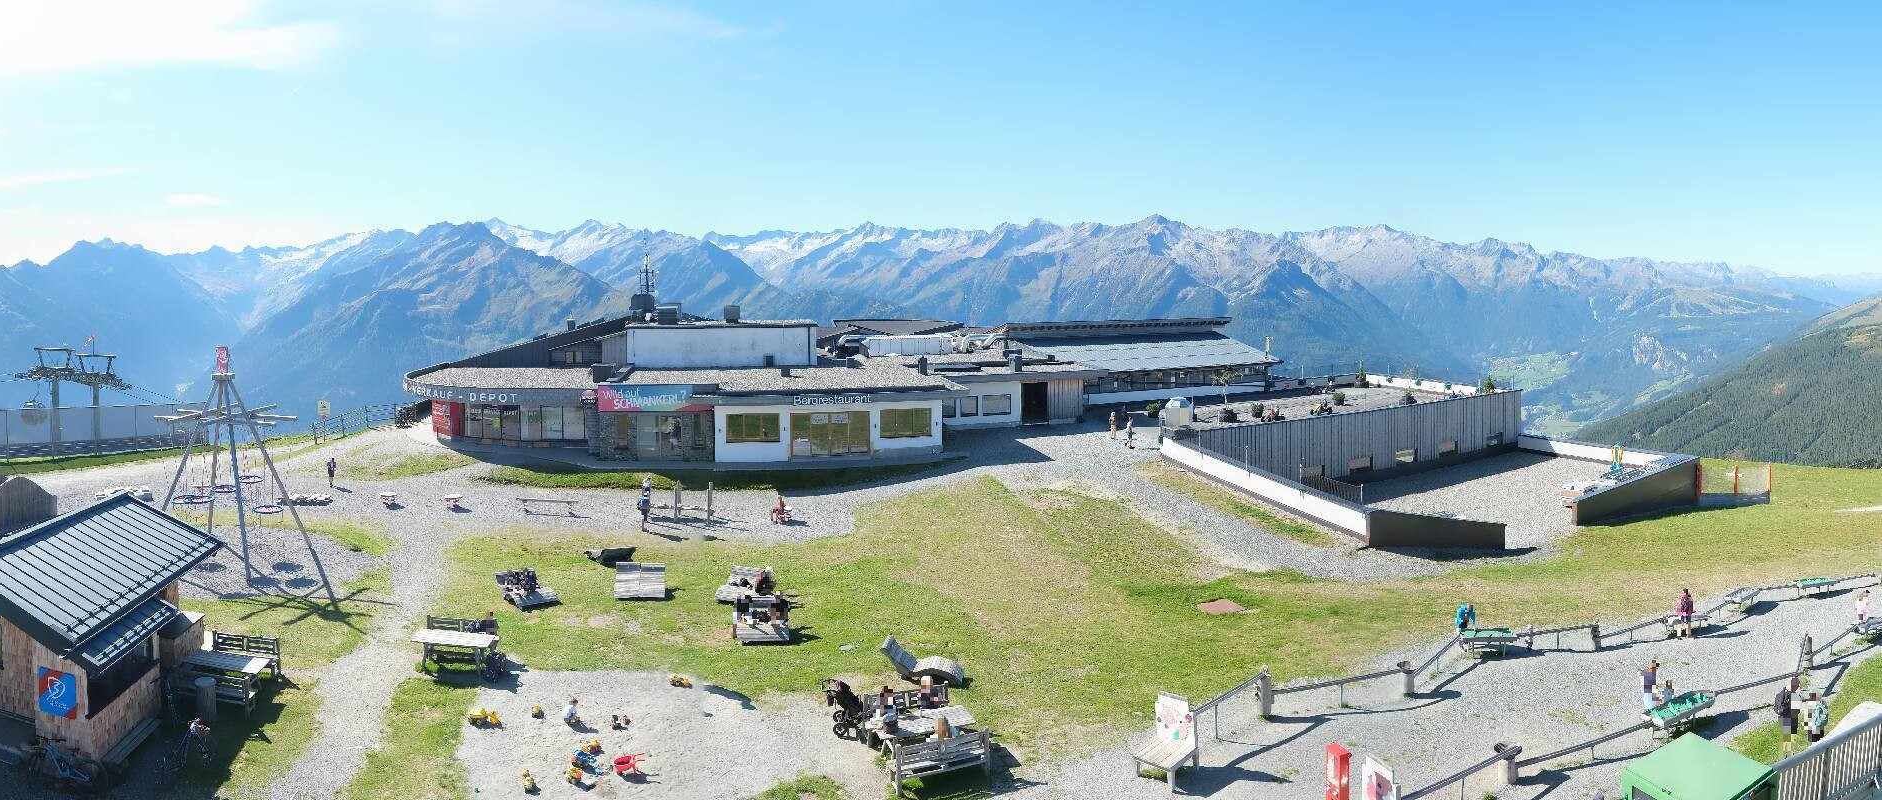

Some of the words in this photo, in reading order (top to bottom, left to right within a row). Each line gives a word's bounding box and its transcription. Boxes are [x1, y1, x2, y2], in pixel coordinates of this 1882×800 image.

[412, 386, 453, 399] VERKAUF
[469, 392, 517, 403] DEPOT
[603, 388, 623, 400] Wild
[625, 386, 640, 398] auf
[613, 389, 687, 410] SCHMANKERL?
[793, 393, 872, 406] Bergrestaurant
